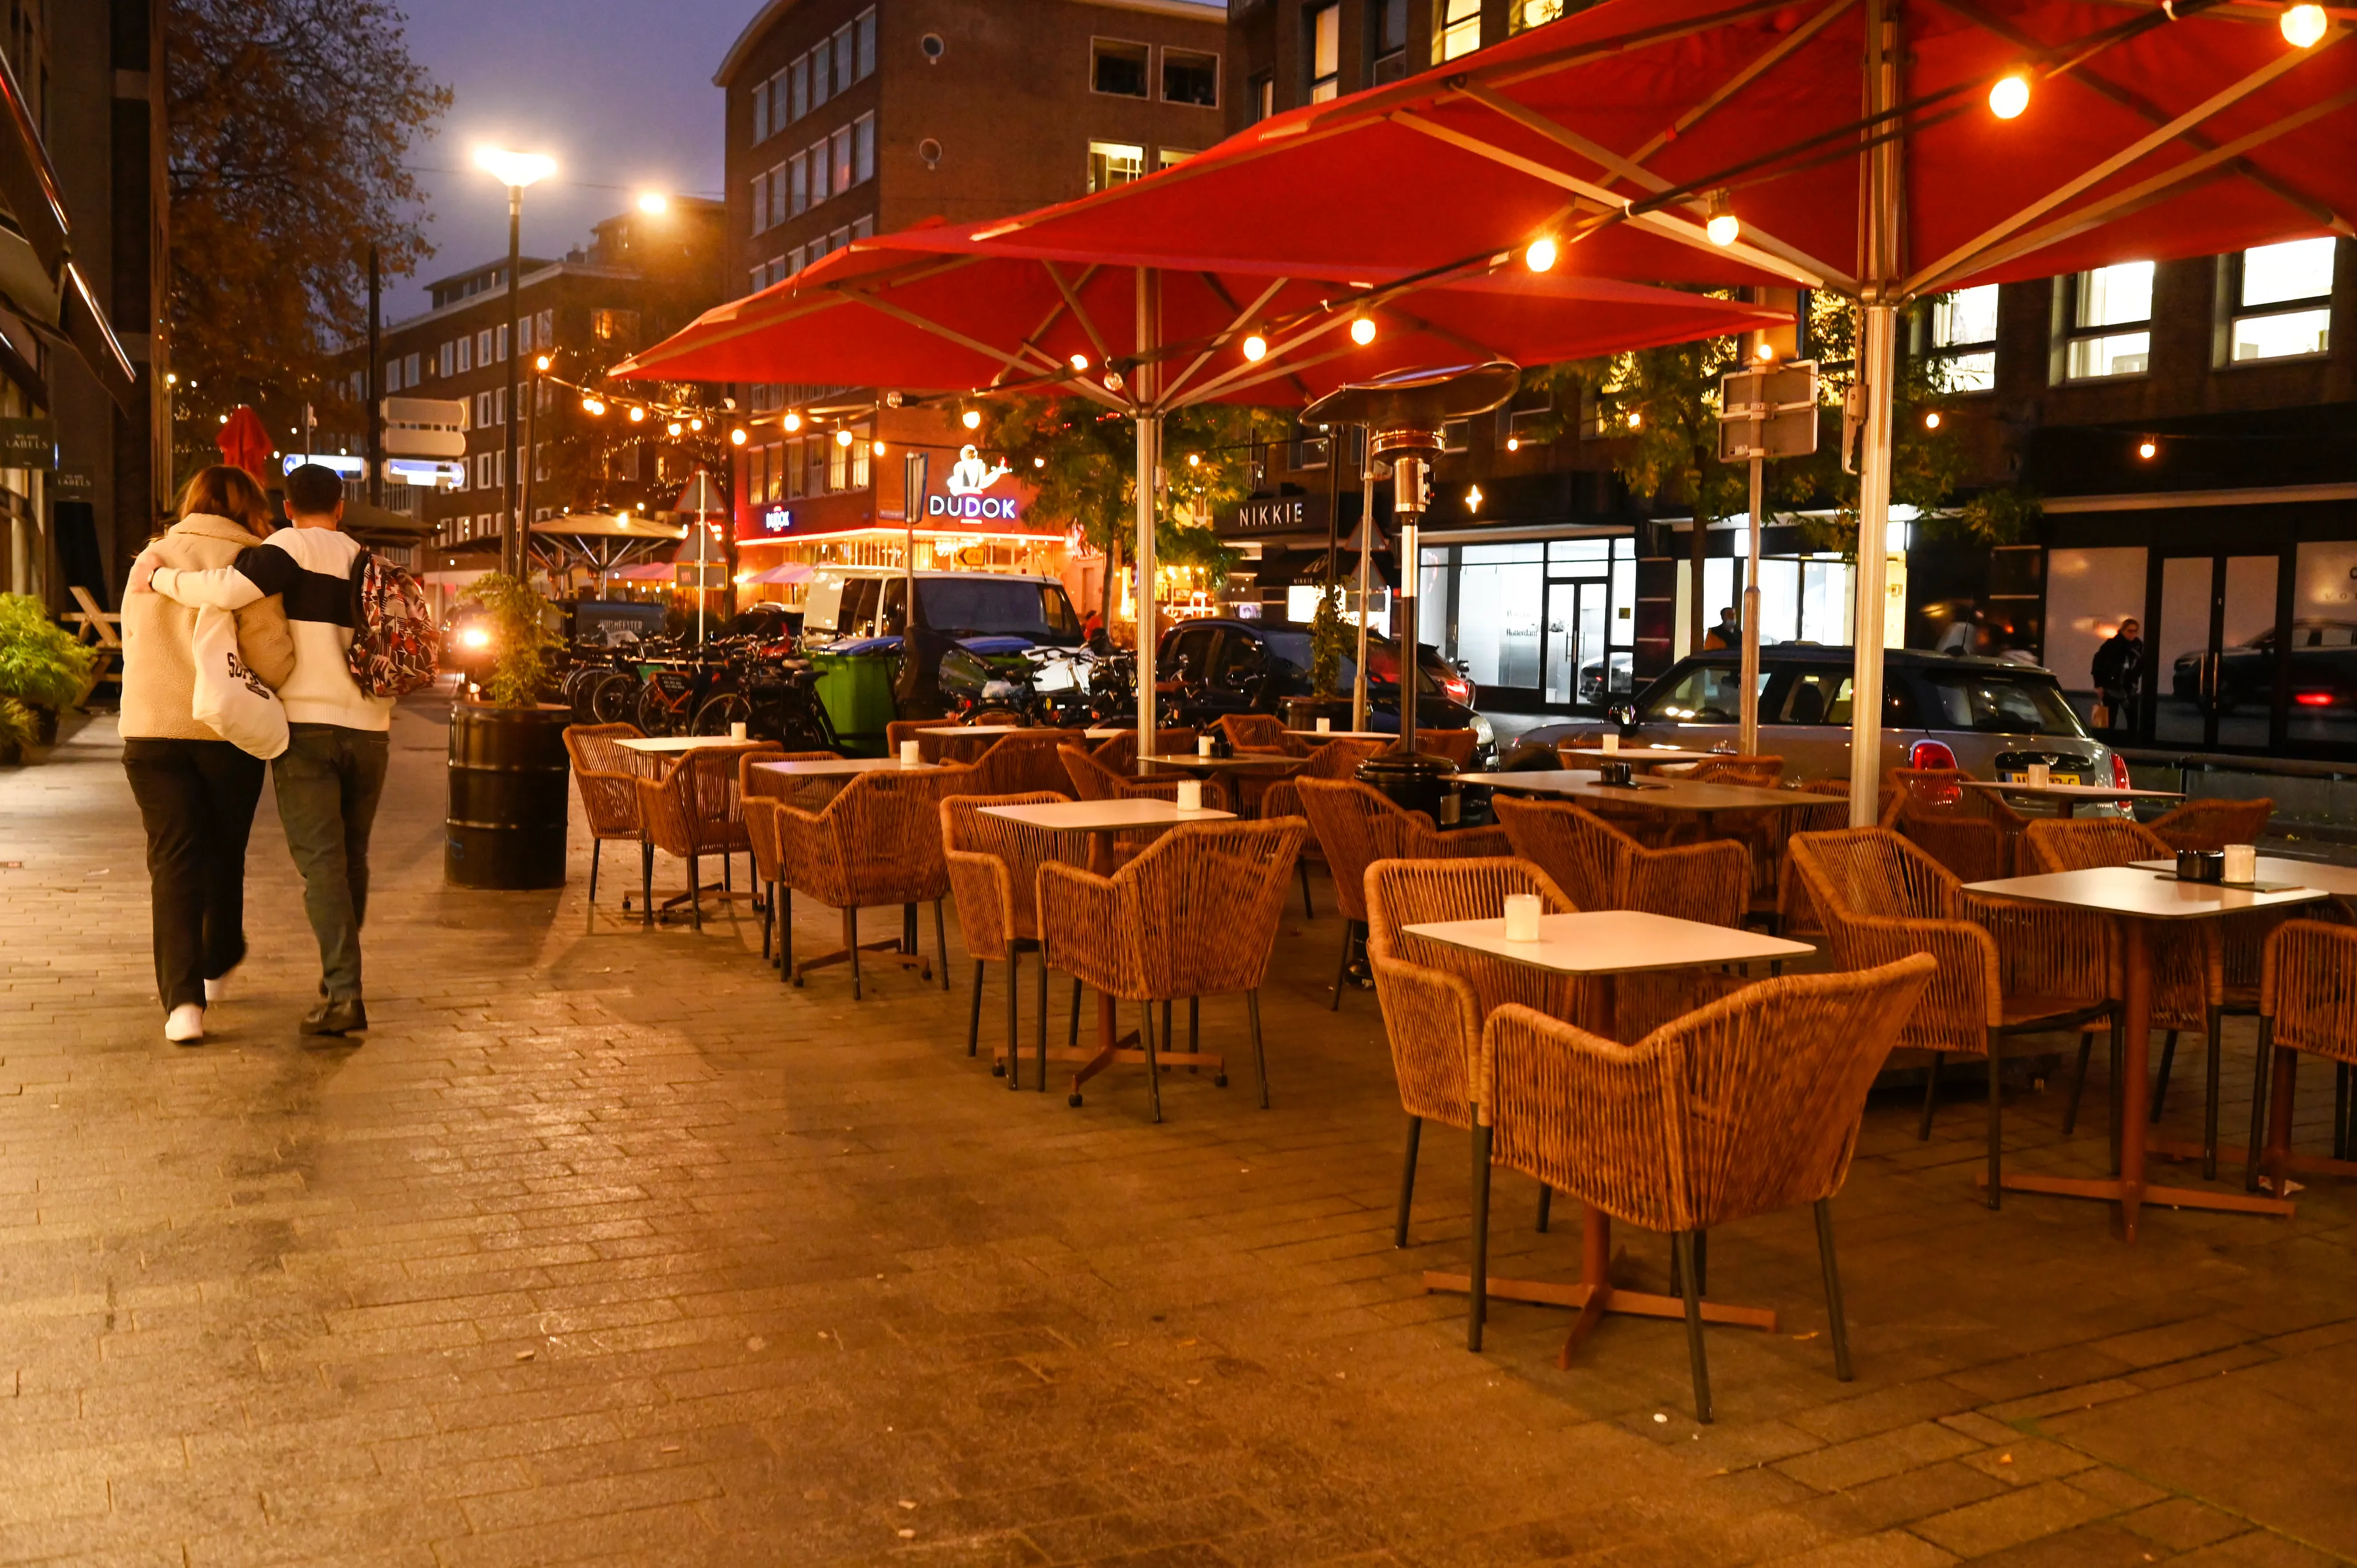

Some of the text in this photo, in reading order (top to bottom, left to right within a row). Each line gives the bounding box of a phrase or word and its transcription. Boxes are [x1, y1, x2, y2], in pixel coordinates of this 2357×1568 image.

[6, 439, 48, 449] LABELS
[930, 495, 1015, 519] DUDOK
[1240, 503, 1302, 527] NIKKIE
[765, 511, 790, 528] DUDOK
[1506, 628, 1538, 637] Rotterdam
